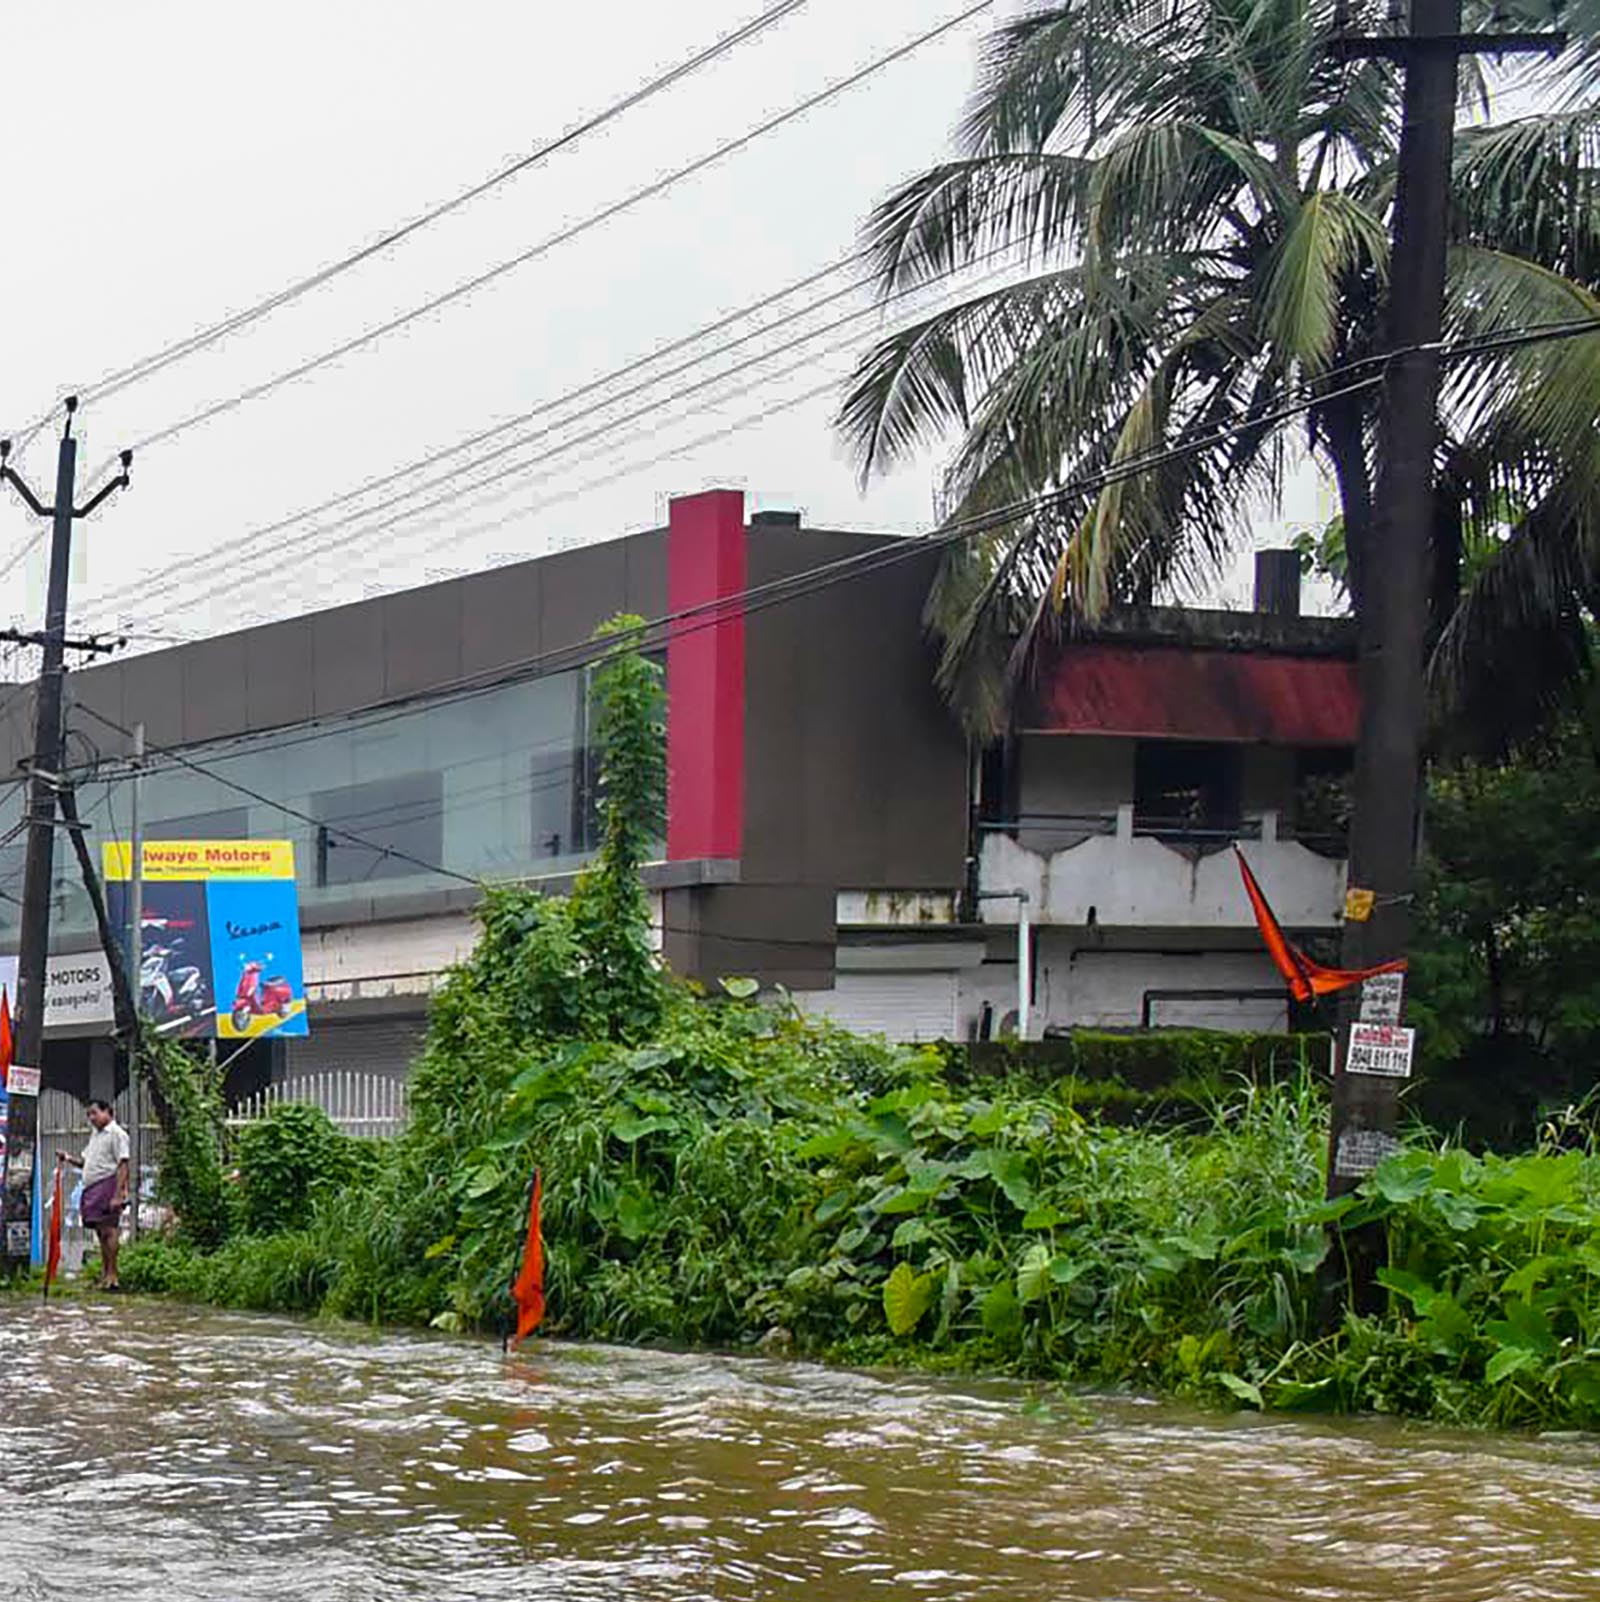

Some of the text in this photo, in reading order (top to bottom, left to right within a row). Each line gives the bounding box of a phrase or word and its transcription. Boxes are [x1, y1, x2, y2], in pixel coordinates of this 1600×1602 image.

[143, 849, 271, 865] lwaye Motors
[51, 968, 100, 985] MOTORS
